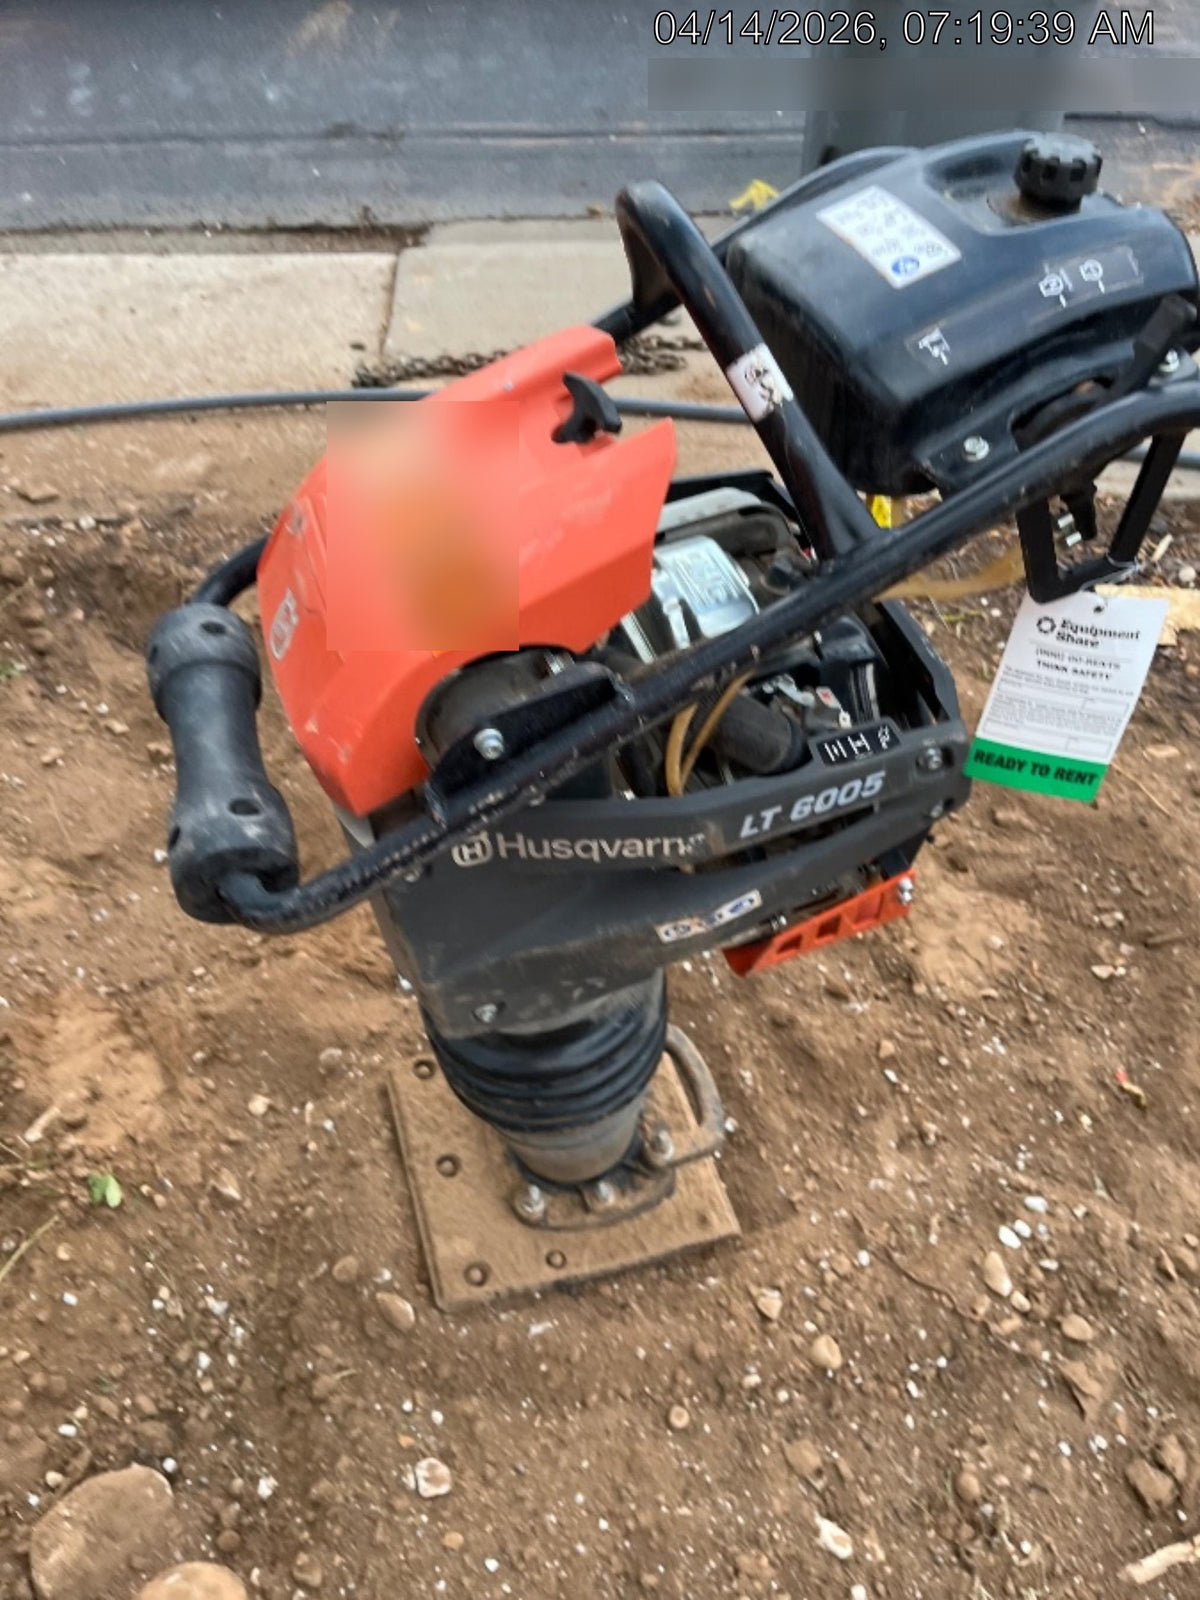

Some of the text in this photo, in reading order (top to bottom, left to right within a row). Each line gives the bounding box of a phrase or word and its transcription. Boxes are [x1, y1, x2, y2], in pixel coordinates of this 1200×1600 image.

[1056, 630, 1100, 648] Share
[973, 749, 1099, 786] READY TO RENT
[740, 770, 886, 839] LT 6005
